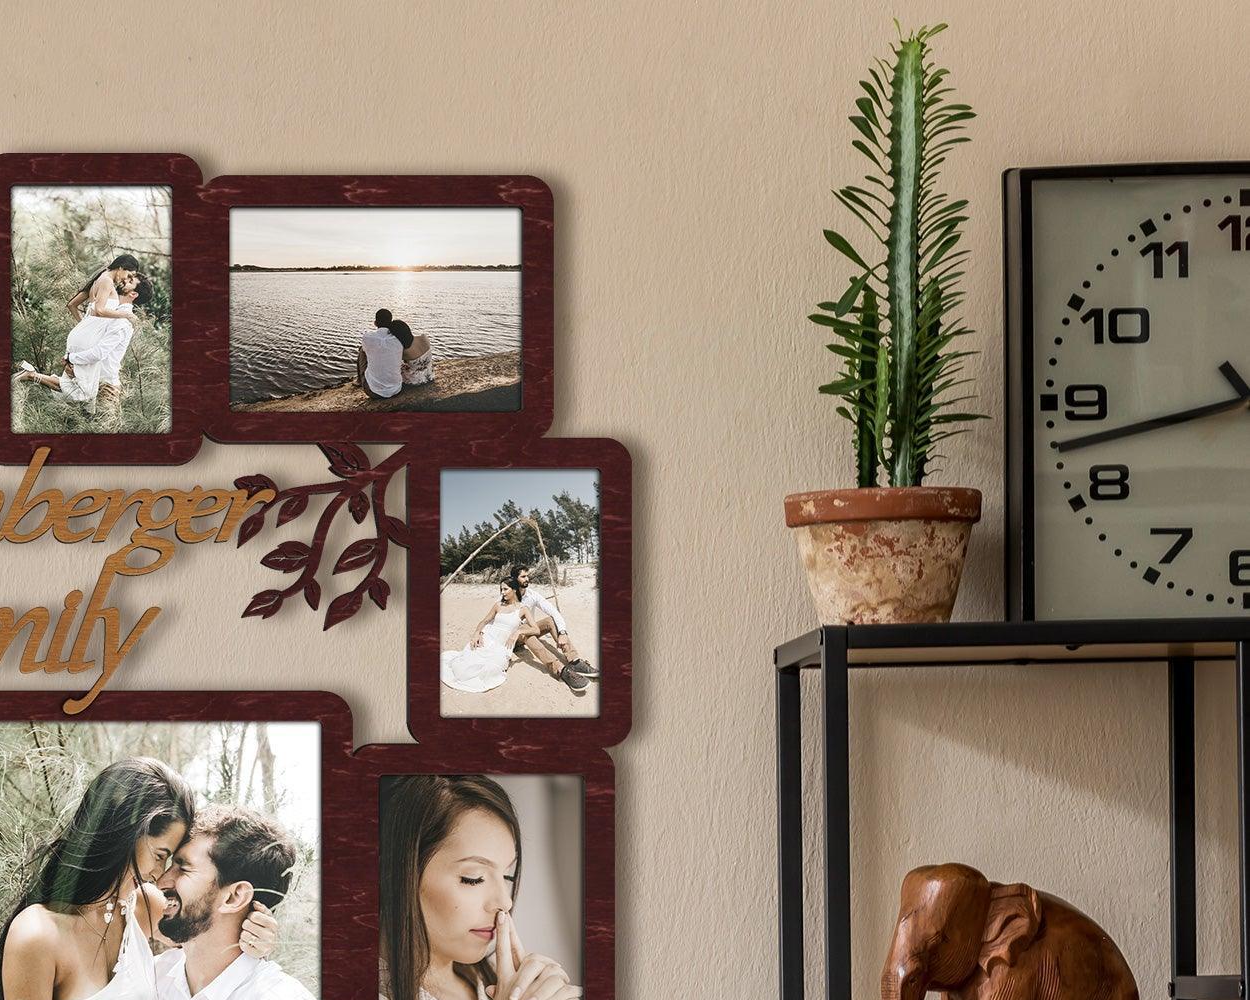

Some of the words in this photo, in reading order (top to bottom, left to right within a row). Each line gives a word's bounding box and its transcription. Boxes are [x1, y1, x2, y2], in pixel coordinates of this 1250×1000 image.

[1217, 215, 1250, 251] 1
[1141, 242, 1188, 278] 11
[1080, 308, 1150, 344] 10
[1065, 384, 1107, 420] 9
[1089, 464, 1130, 500] 8
[1150, 528, 1193, 564] 7
